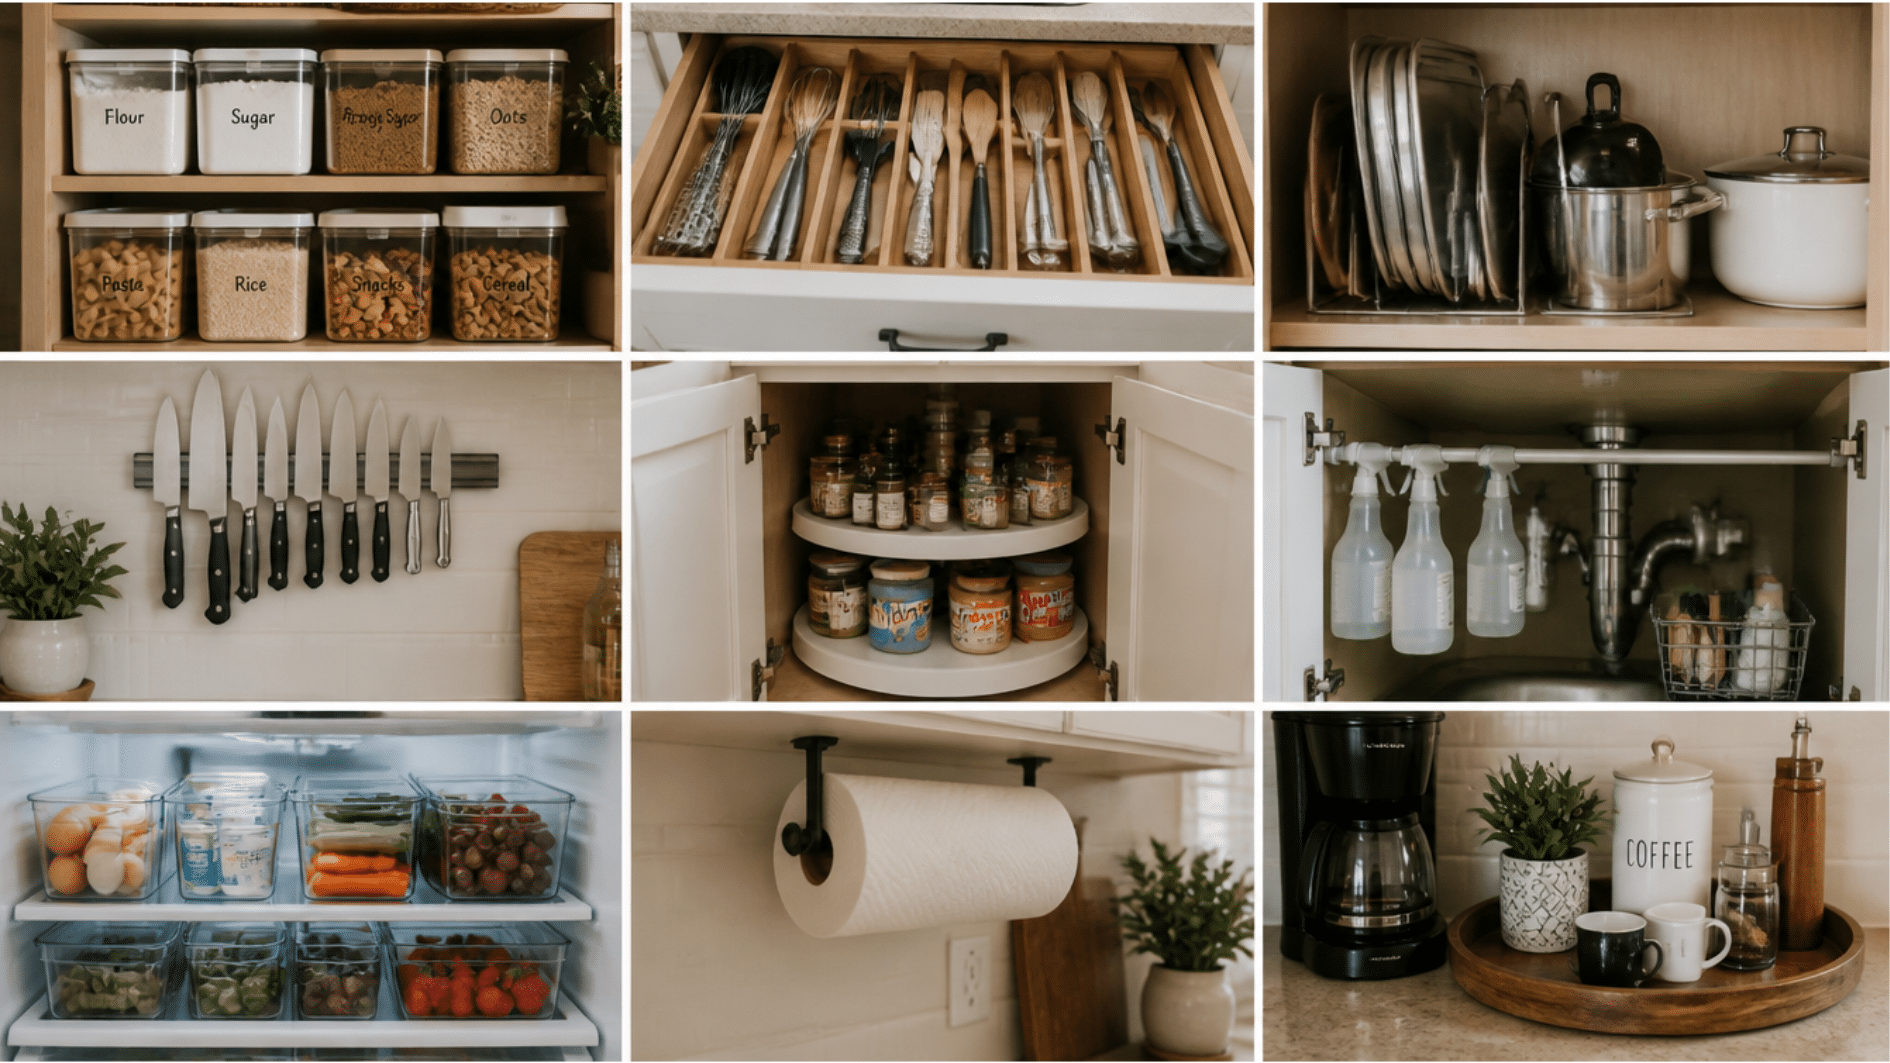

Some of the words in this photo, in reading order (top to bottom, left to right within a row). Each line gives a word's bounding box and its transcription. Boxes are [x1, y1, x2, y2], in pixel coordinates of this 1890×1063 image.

[105, 108, 145, 125] Flour
[231, 108, 276, 130] Sugar
[235, 275, 267, 293] Rice
[352, 275, 405, 293] Snacks
[483, 274, 531, 292] Cereal
[1626, 838, 1694, 870] COFFEE
